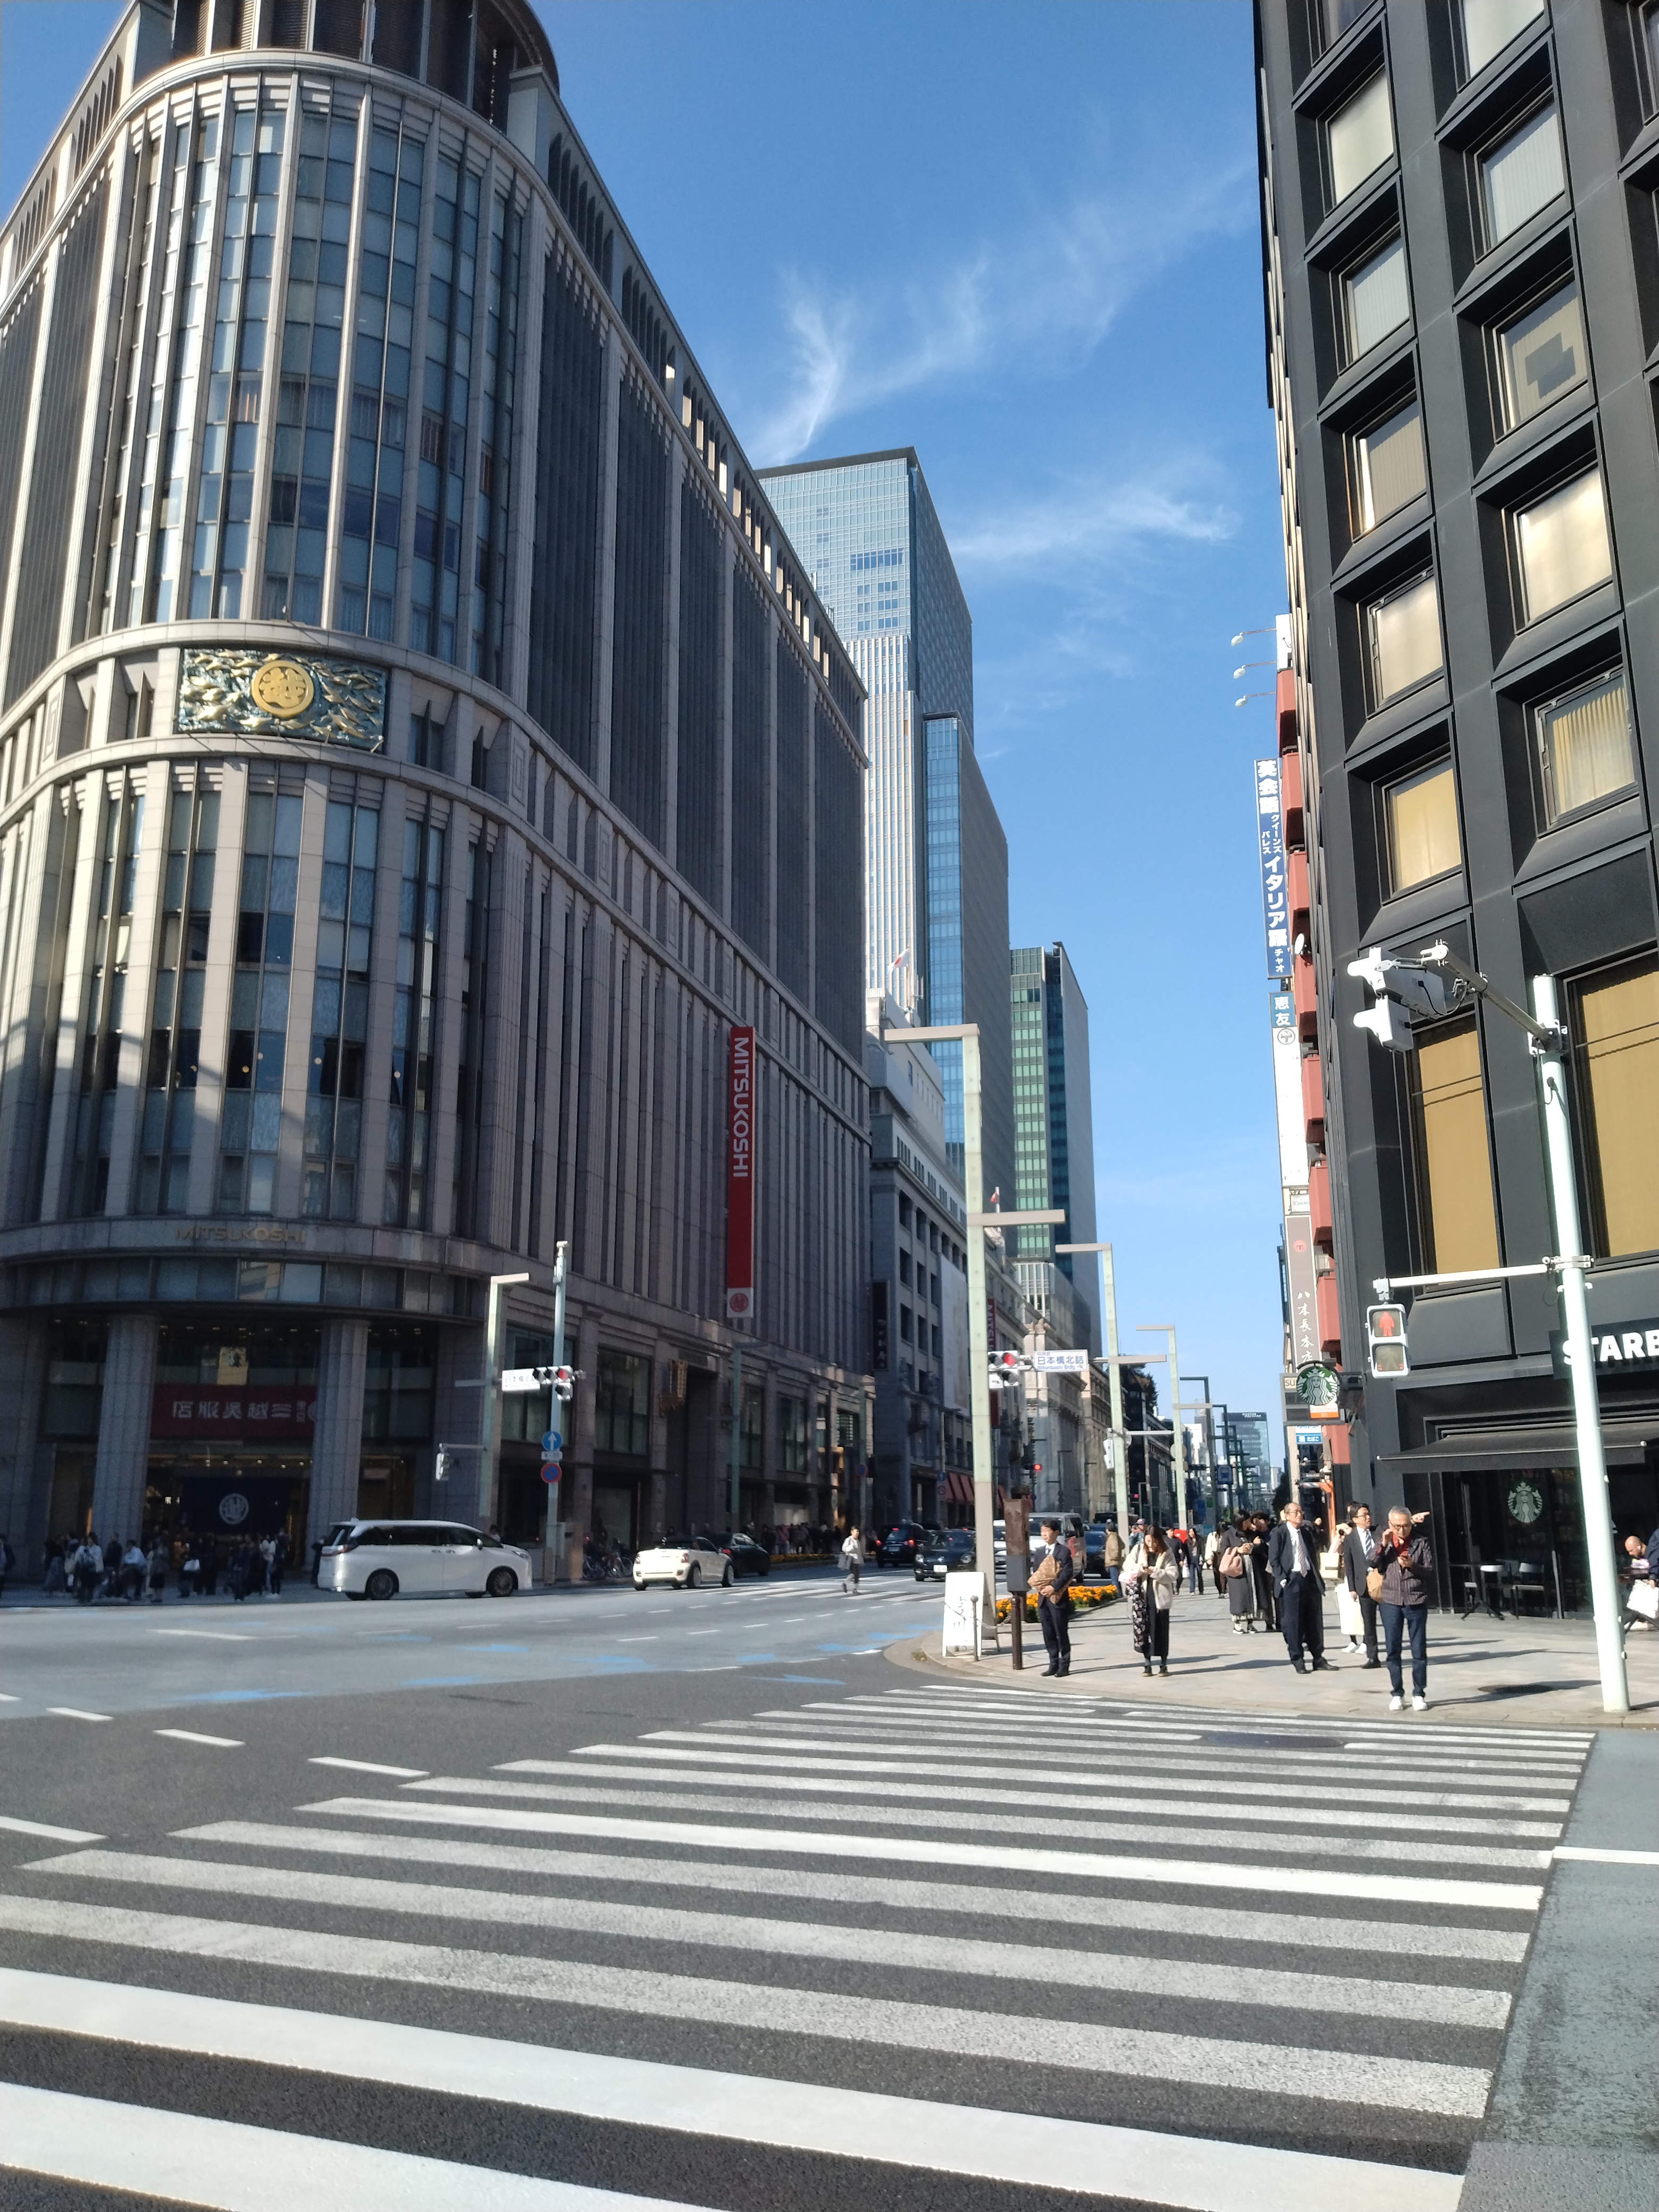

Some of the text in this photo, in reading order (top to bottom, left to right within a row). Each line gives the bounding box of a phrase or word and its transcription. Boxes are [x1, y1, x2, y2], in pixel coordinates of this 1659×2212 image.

[1257, 760, 1279, 814] 英会話
[1262, 831, 1271, 855] パレス
[1271, 814, 1282, 853] クイーンズ
[1264, 856, 1287, 947] イタリア語
[1274, 948, 1285, 973] チャオ
[733, 1037, 749, 1177] MITSUKOSHI
[176, 1226, 306, 1243] MITSUKOSHI
[1037, 1356, 1084, 1365] 日本橋北詰
[1562, 1329, 1659, 1365] ARB
